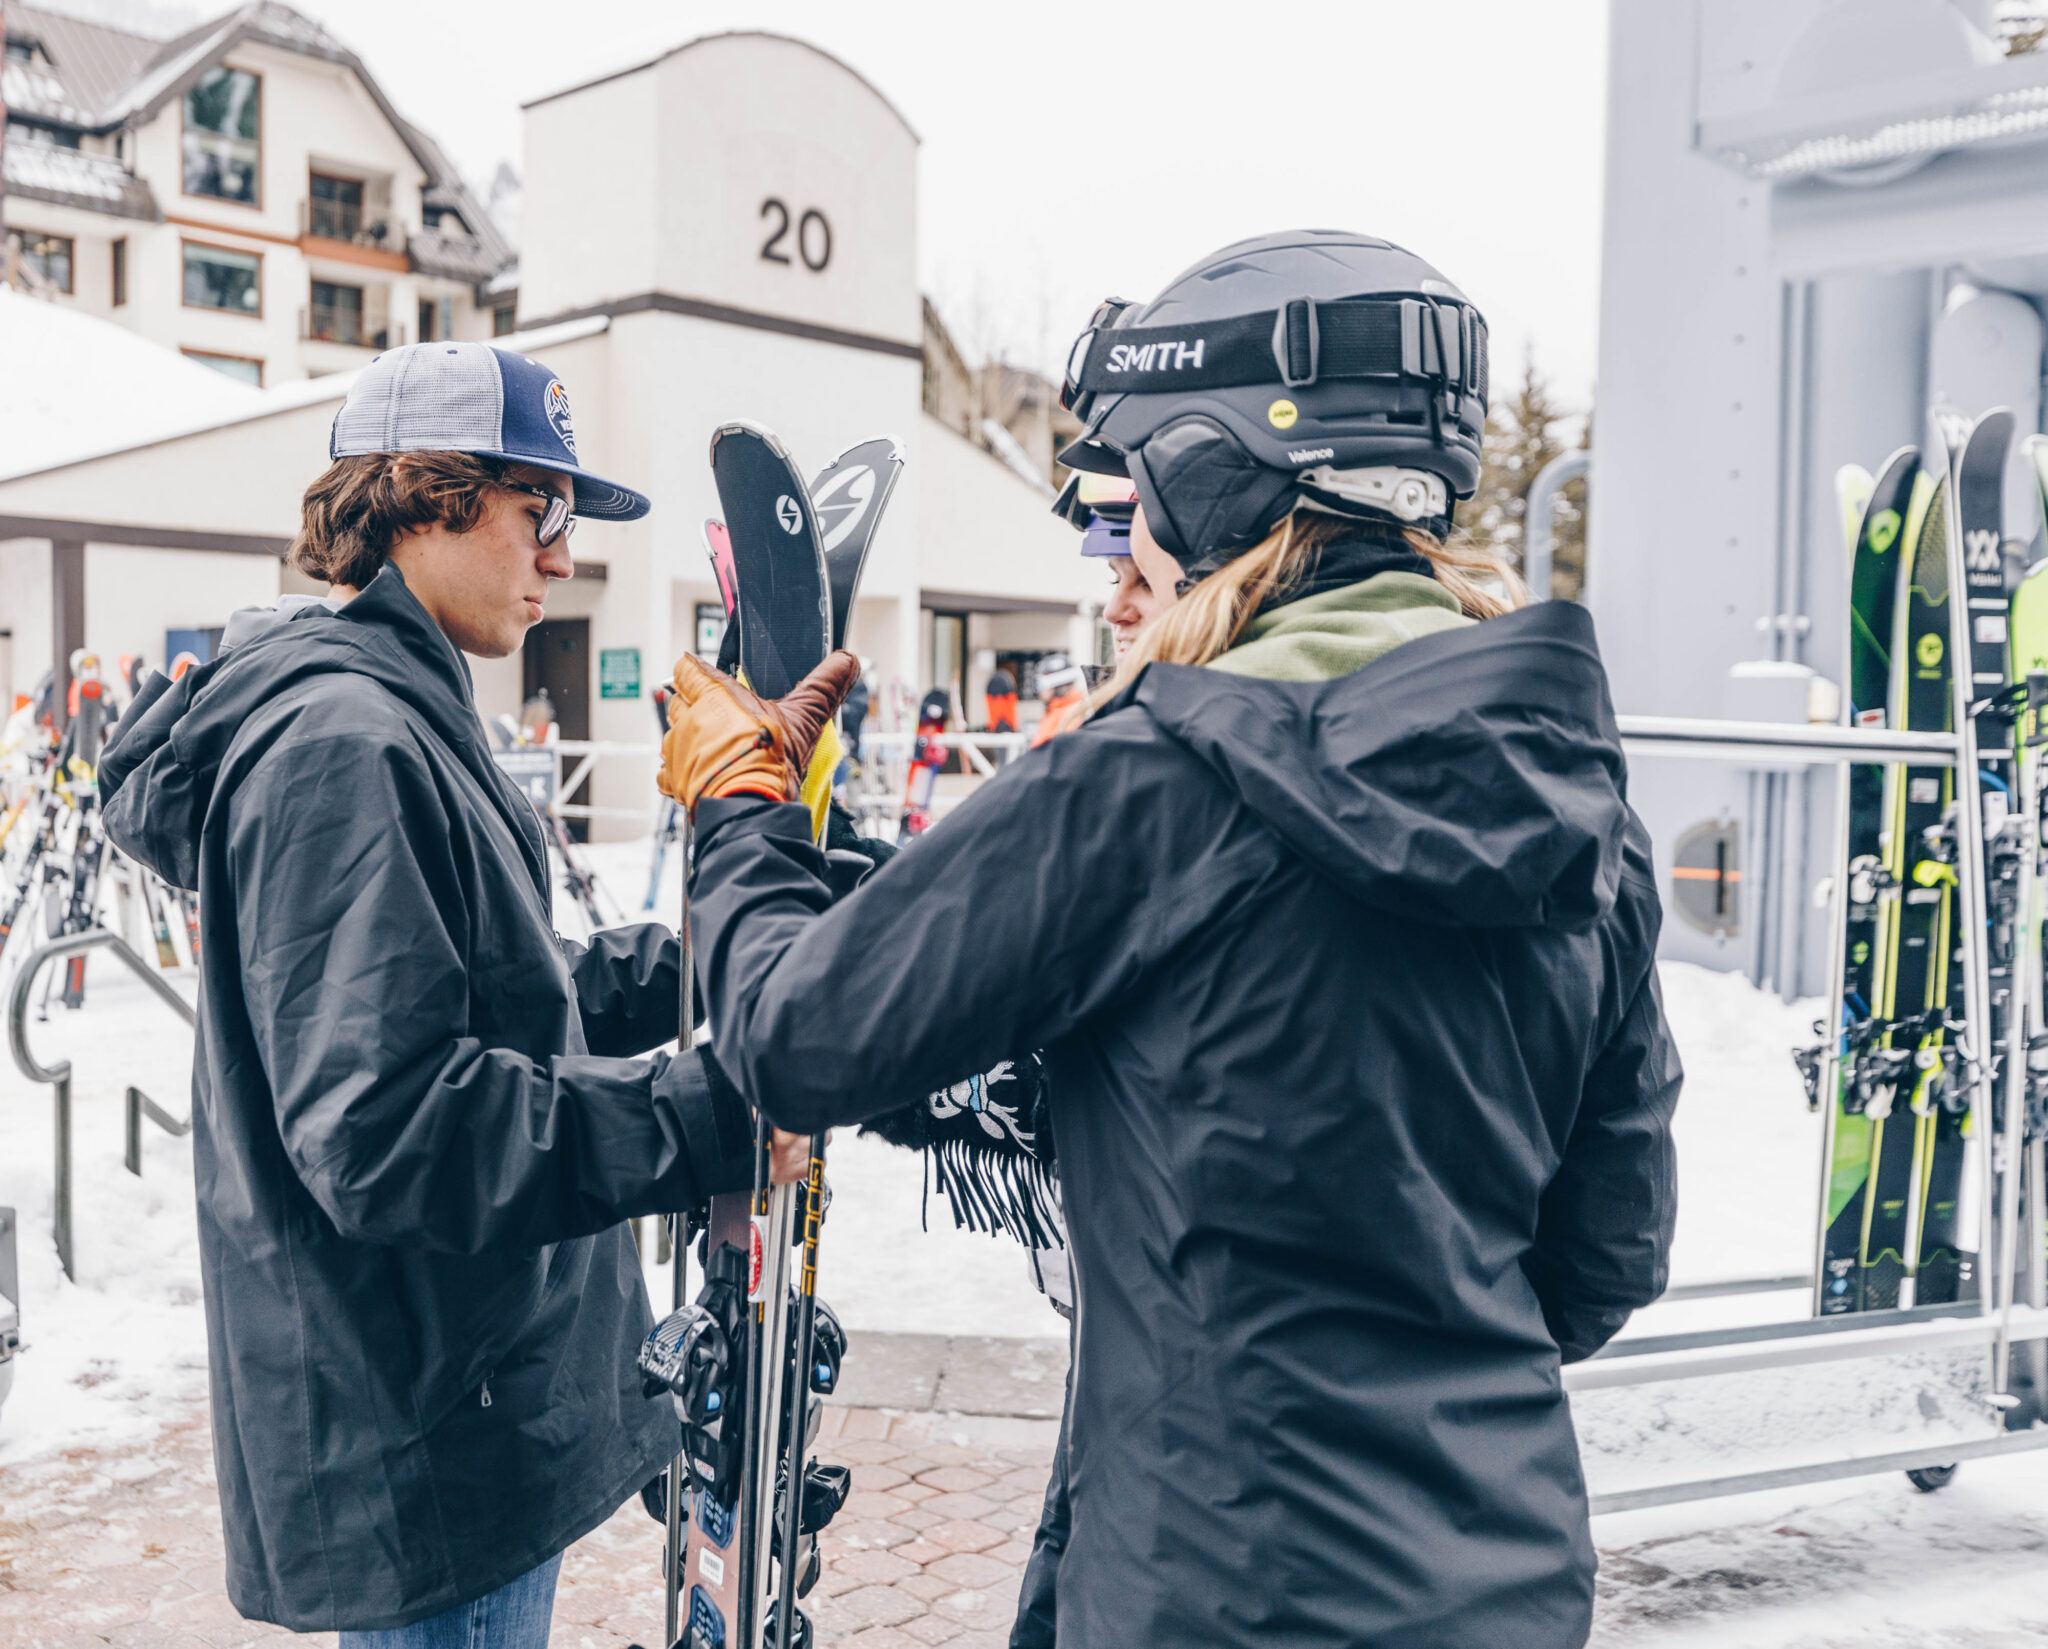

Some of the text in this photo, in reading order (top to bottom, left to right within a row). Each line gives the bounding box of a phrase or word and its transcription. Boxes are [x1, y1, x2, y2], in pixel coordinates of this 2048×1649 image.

[760, 198, 832, 273] 20
[1106, 338, 1205, 373] SMITH
[1287, 447, 1335, 464] Valence
